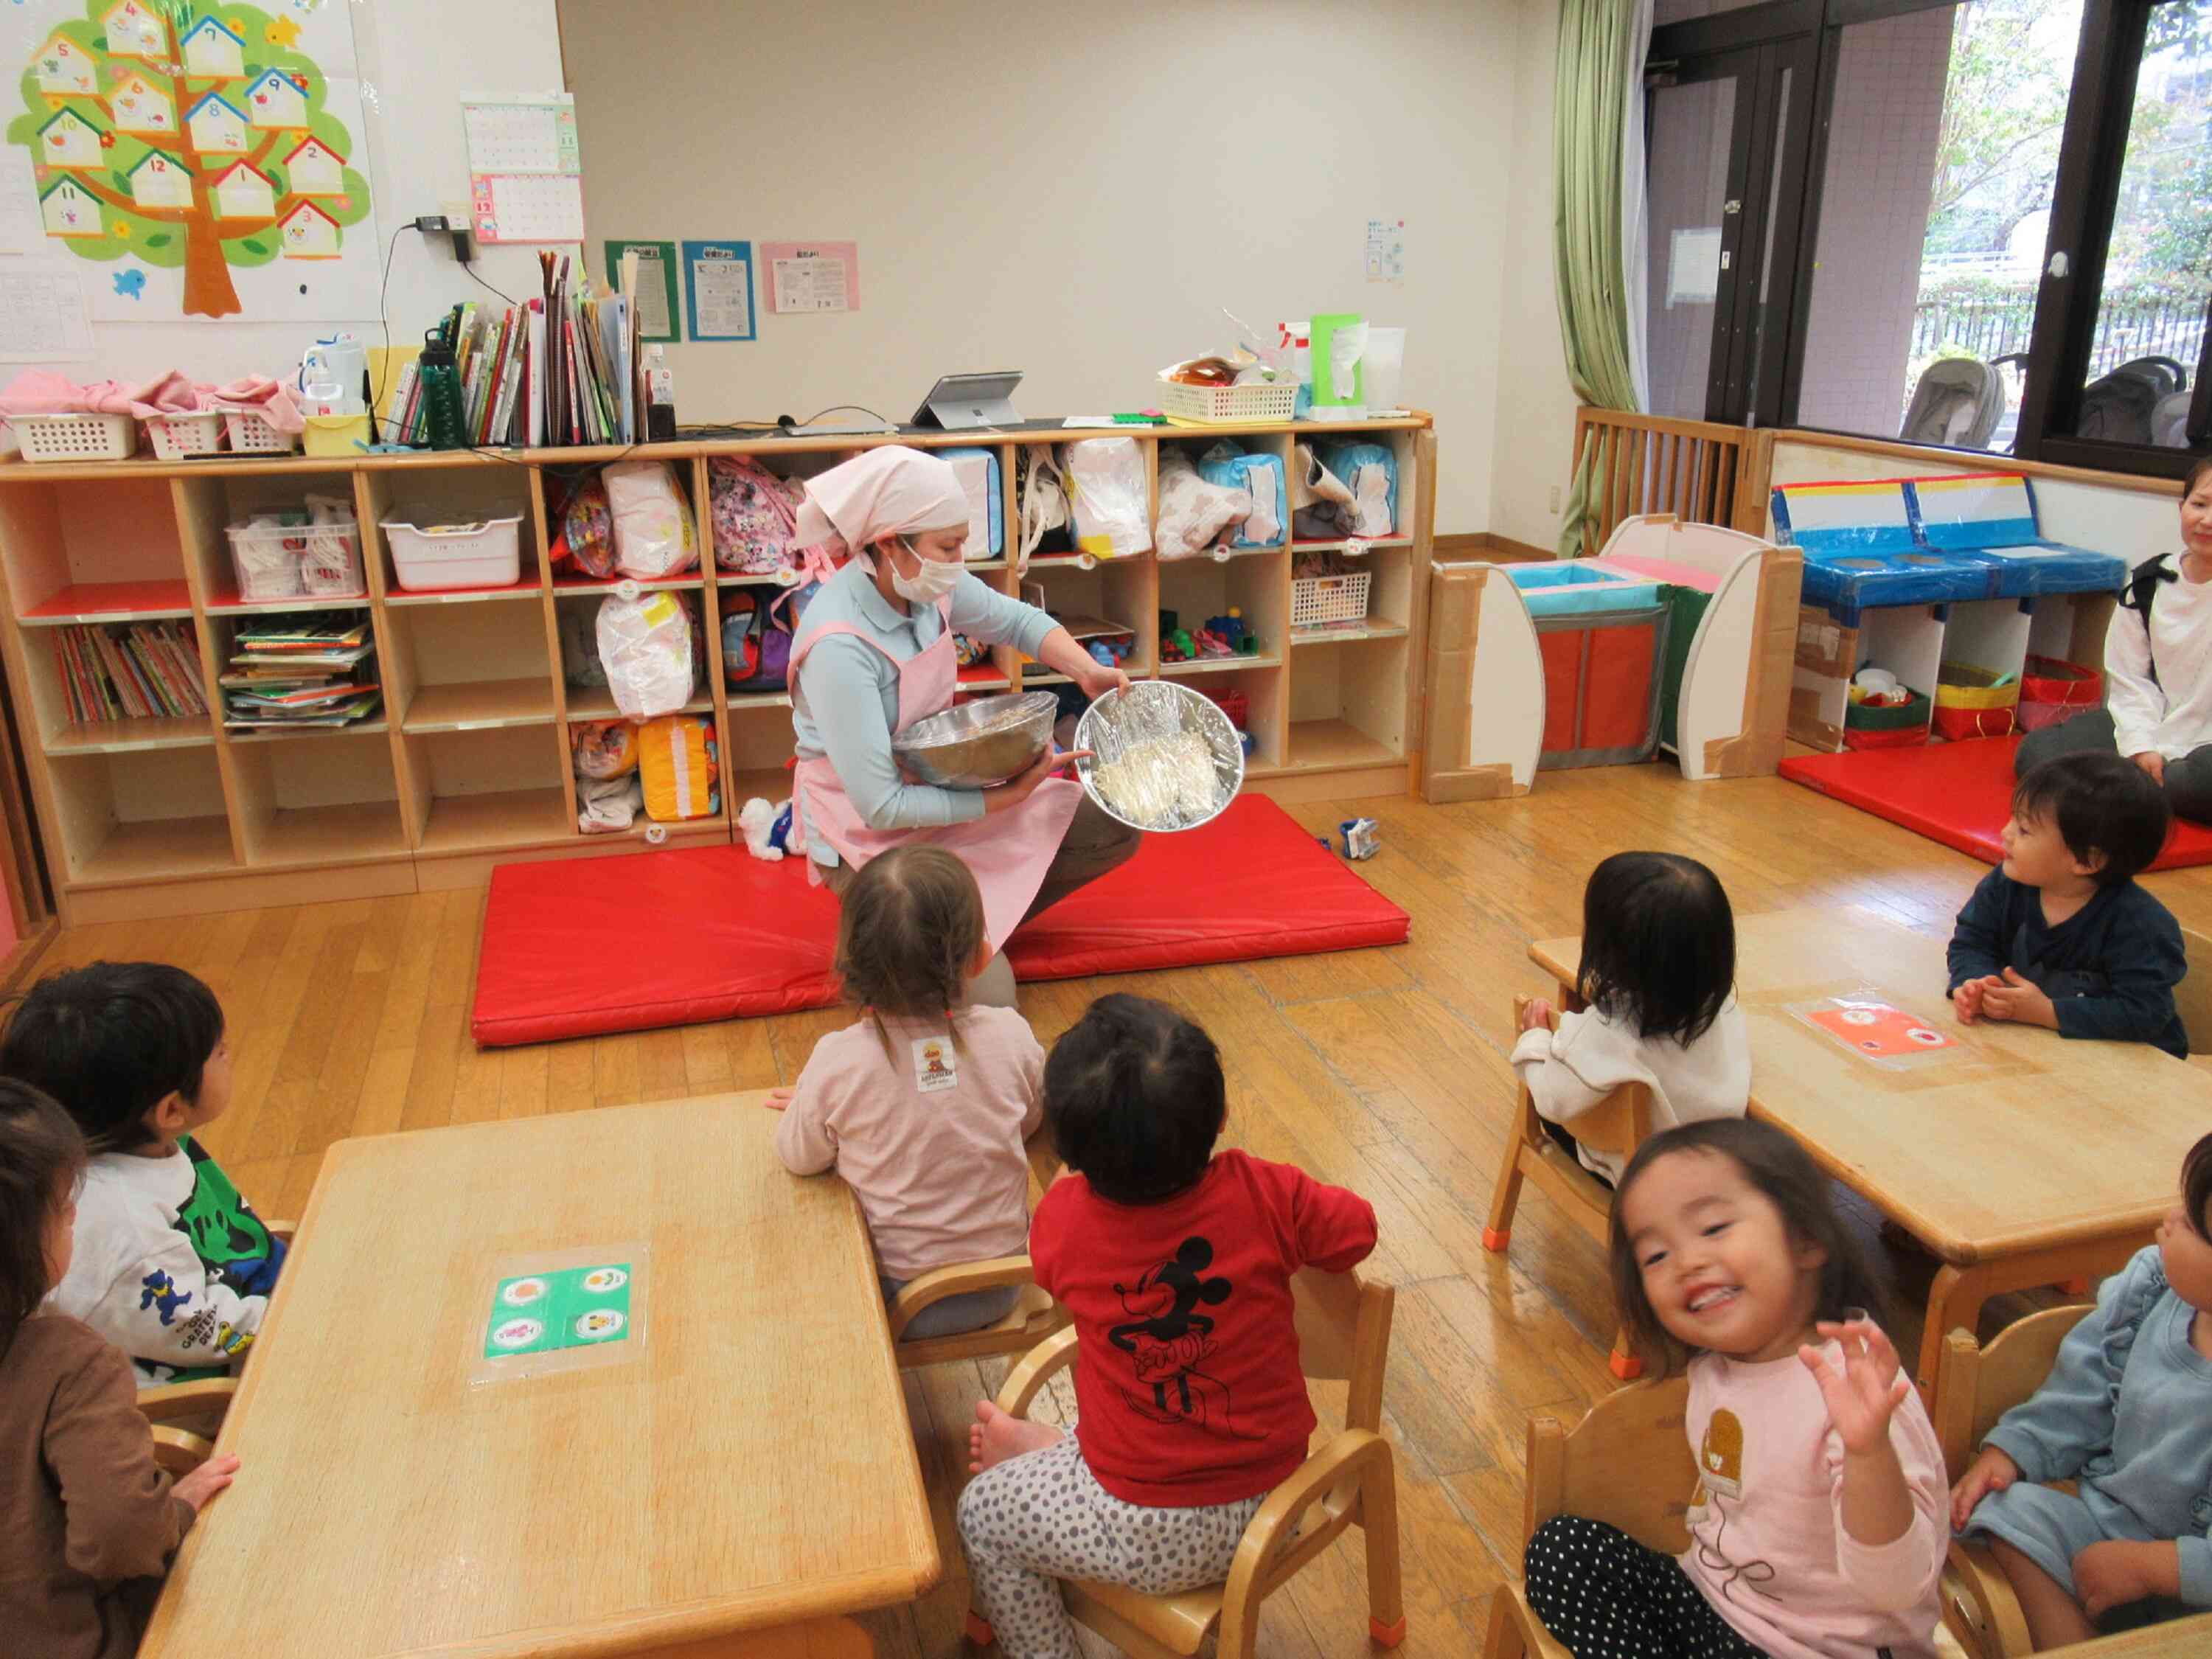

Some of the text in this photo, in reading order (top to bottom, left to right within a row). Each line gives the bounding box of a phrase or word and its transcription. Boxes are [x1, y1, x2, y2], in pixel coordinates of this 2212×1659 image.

[125, 1, 138, 16] 4
[204, 27, 216, 41] 7
[58, 44, 69, 57] 5
[131, 81, 143, 94] 6
[268, 78, 279, 91] 9
[209, 103, 219, 116] 8
[60, 119, 77, 131] 10
[307, 147, 318, 159] 2
[150, 160, 166, 172] 12
[240, 168, 246, 181] 1
[62, 187, 75, 200] 11
[302, 210, 312, 222] 3
